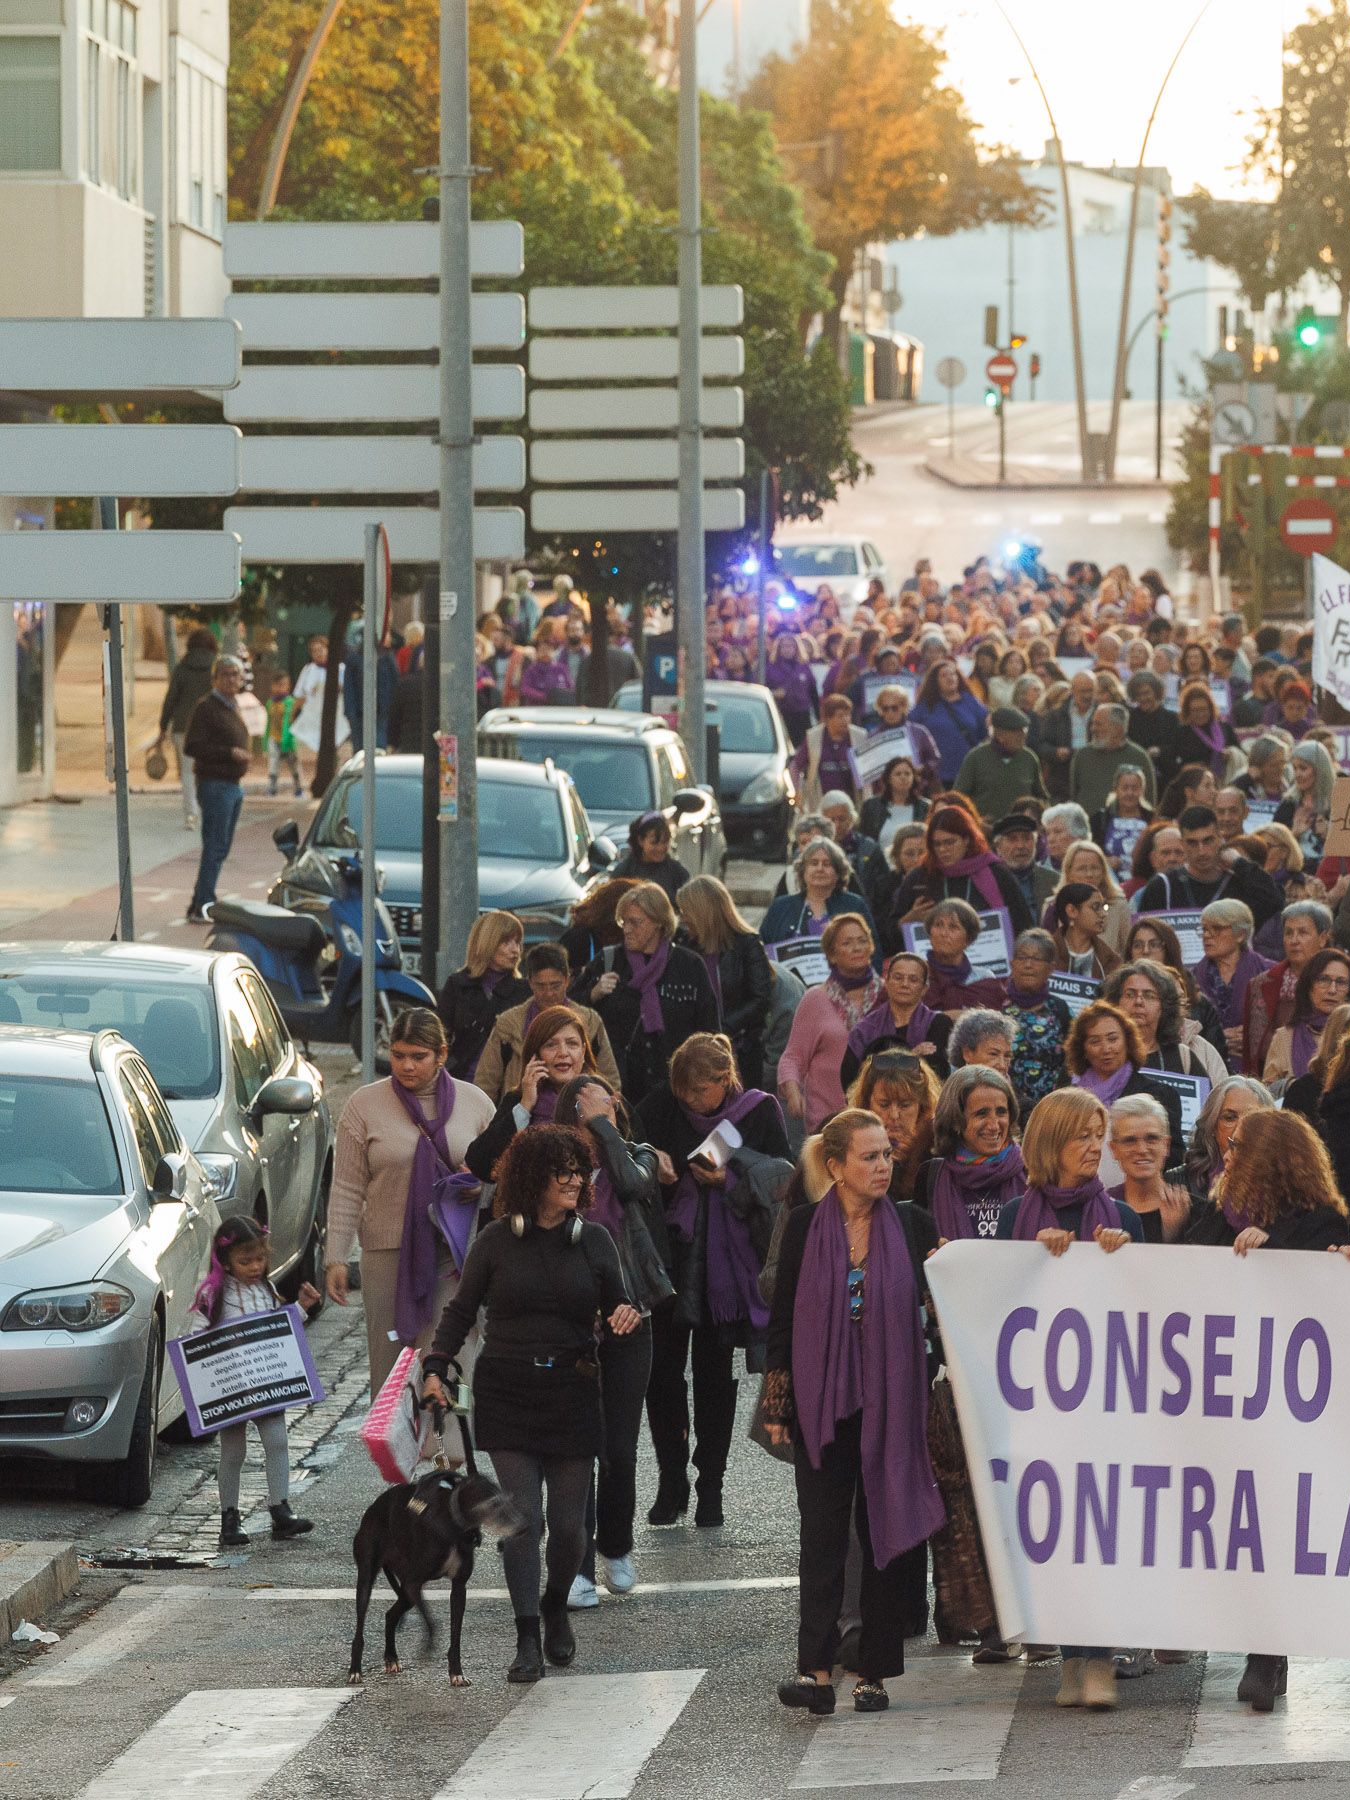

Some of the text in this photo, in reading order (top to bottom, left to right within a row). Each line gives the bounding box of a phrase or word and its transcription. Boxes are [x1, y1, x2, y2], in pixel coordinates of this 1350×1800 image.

[660, 656, 675, 679] P
[1047, 978, 1080, 994] THAIS
[978, 1209, 1000, 1221] MU
[201, 1352, 242, 1369] Asesinada,
[243, 1342, 280, 1356] apuñalada
[214, 1352, 279, 1376] degollada en julio
[995, 1305, 1333, 1424] CONSEJO
[216, 1372, 243, 1386] manos
[244, 1369, 254, 1377] de
[257, 1366, 266, 1374] su
[266, 1361, 288, 1373] pareja
[221, 1381, 247, 1395] Antella
[202, 1382, 309, 1420] STOP VIOLENCIA MACHISTA
[990, 1457, 1265, 1574] ONTRA
